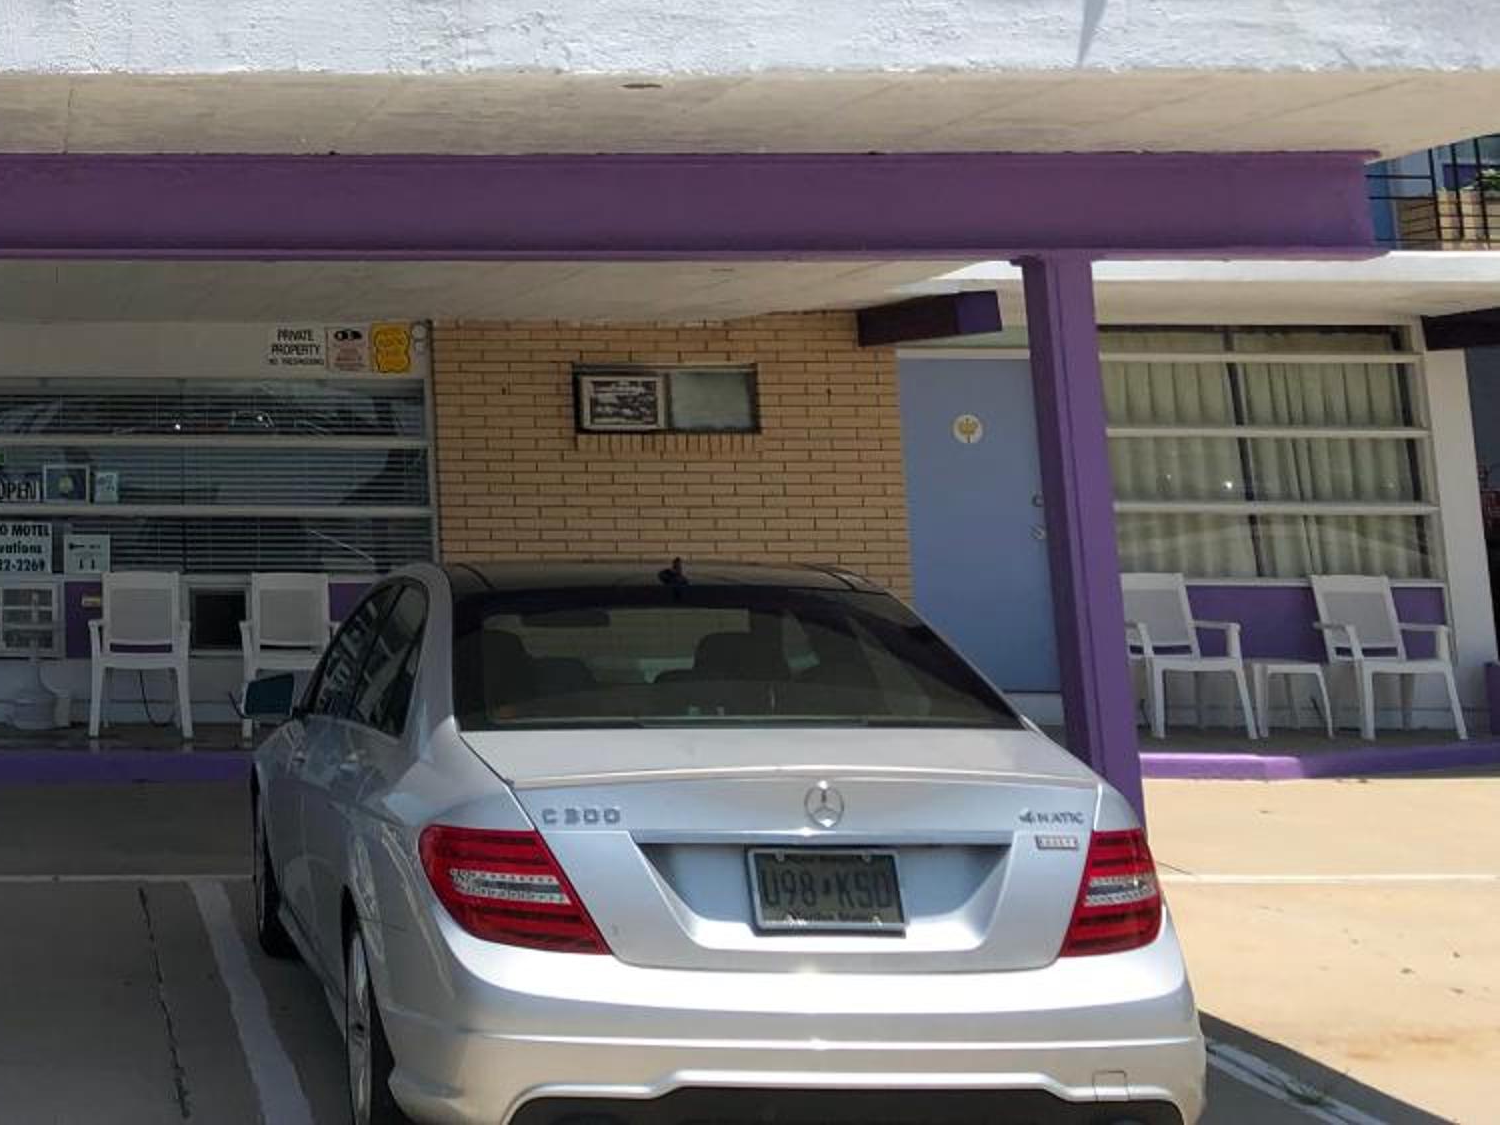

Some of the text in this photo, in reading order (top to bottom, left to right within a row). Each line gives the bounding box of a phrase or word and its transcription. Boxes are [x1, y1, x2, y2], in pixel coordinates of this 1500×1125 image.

[276, 328, 315, 342] PRIVATE
[271, 343, 321, 356] PROPERTY
[11, 523, 50, 537] MOTEL
[541, 807, 621, 826] C 300
